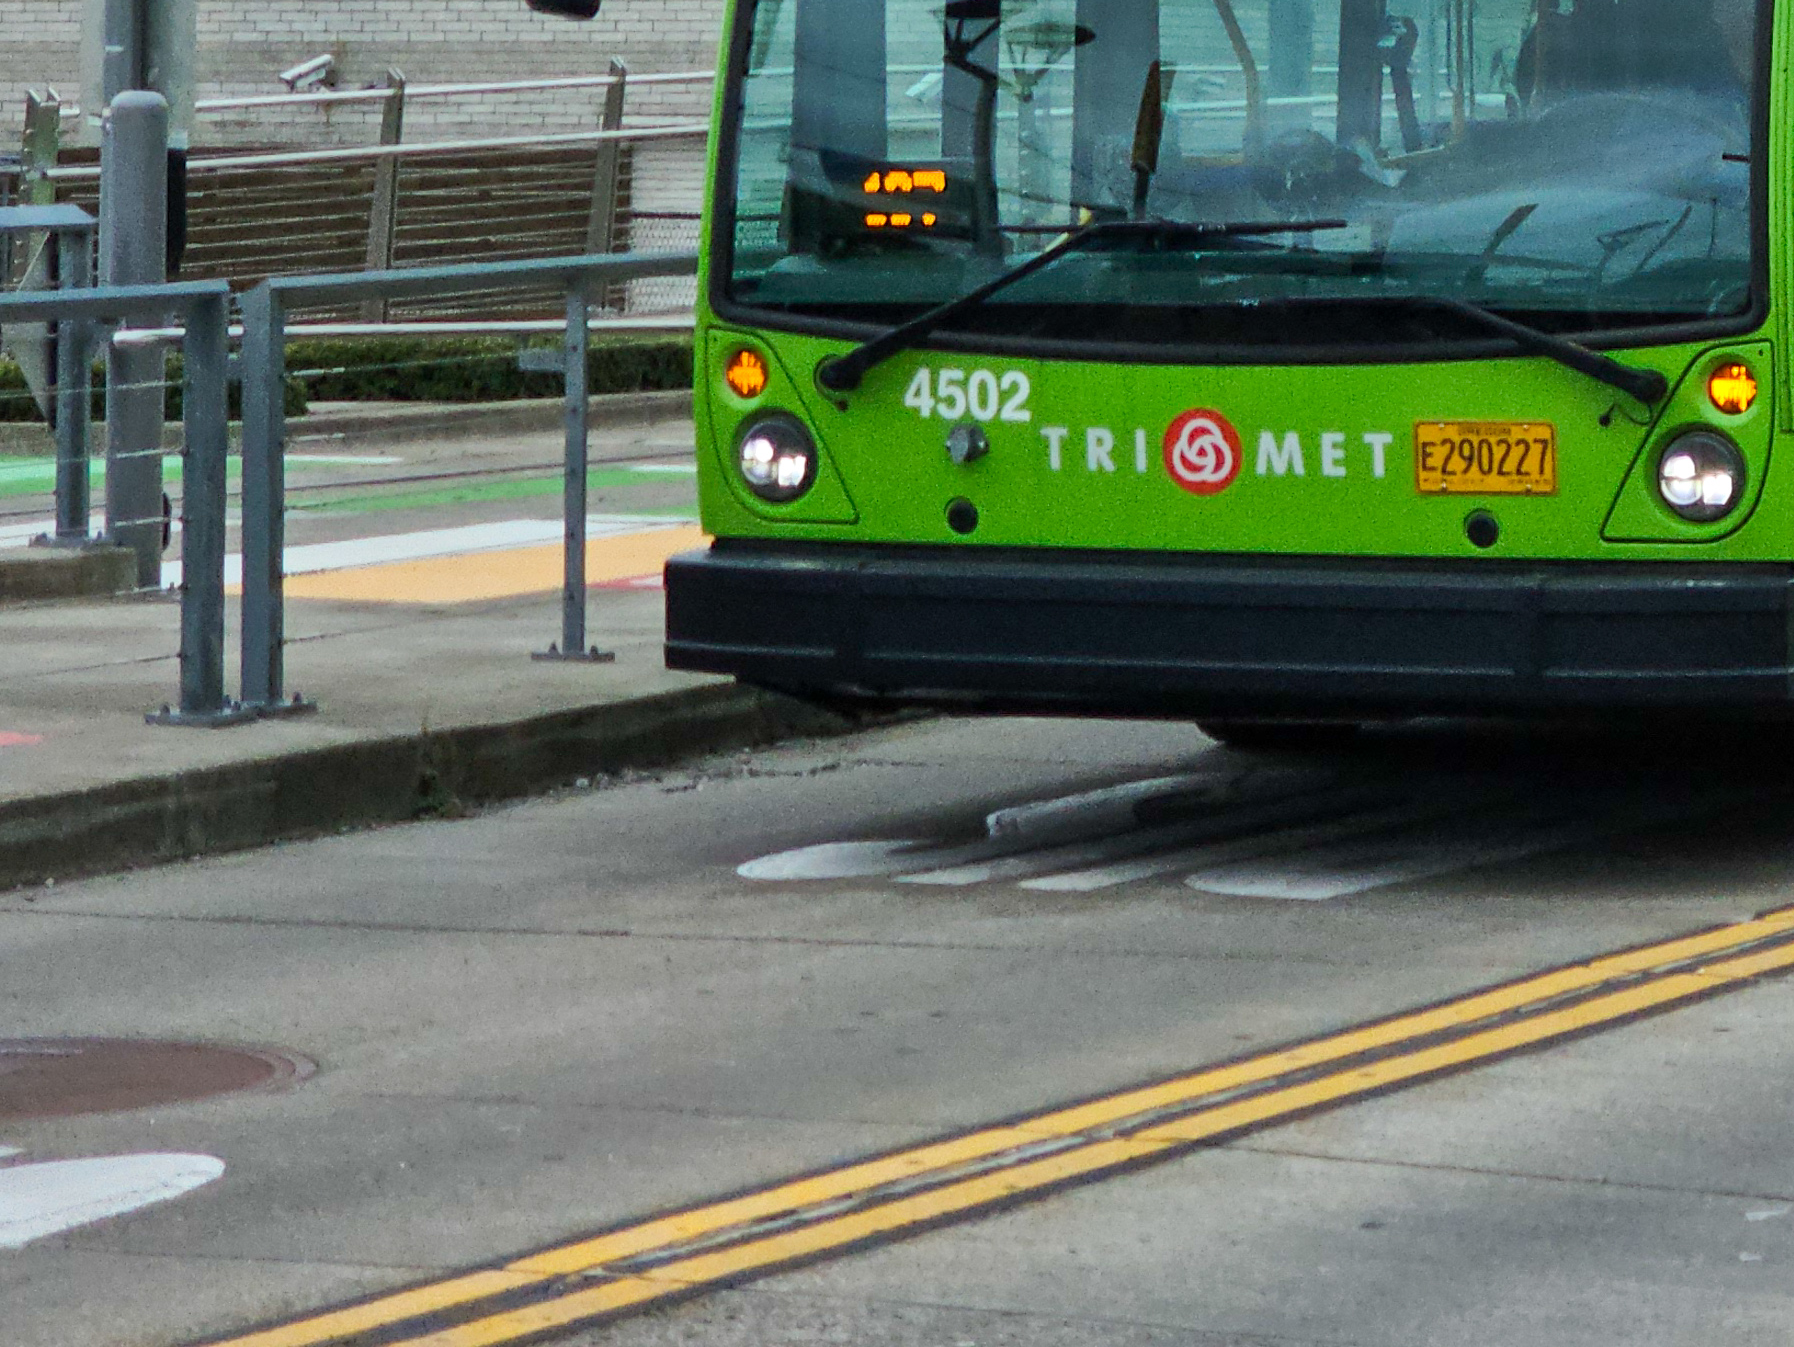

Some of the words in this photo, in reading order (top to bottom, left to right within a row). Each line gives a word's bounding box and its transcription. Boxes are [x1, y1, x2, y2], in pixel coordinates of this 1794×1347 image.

[904, 367, 1031, 421] 4502
[1040, 426, 1148, 472] TRI
[1255, 430, 1394, 477] MET
[1421, 438, 1549, 476] E290227
